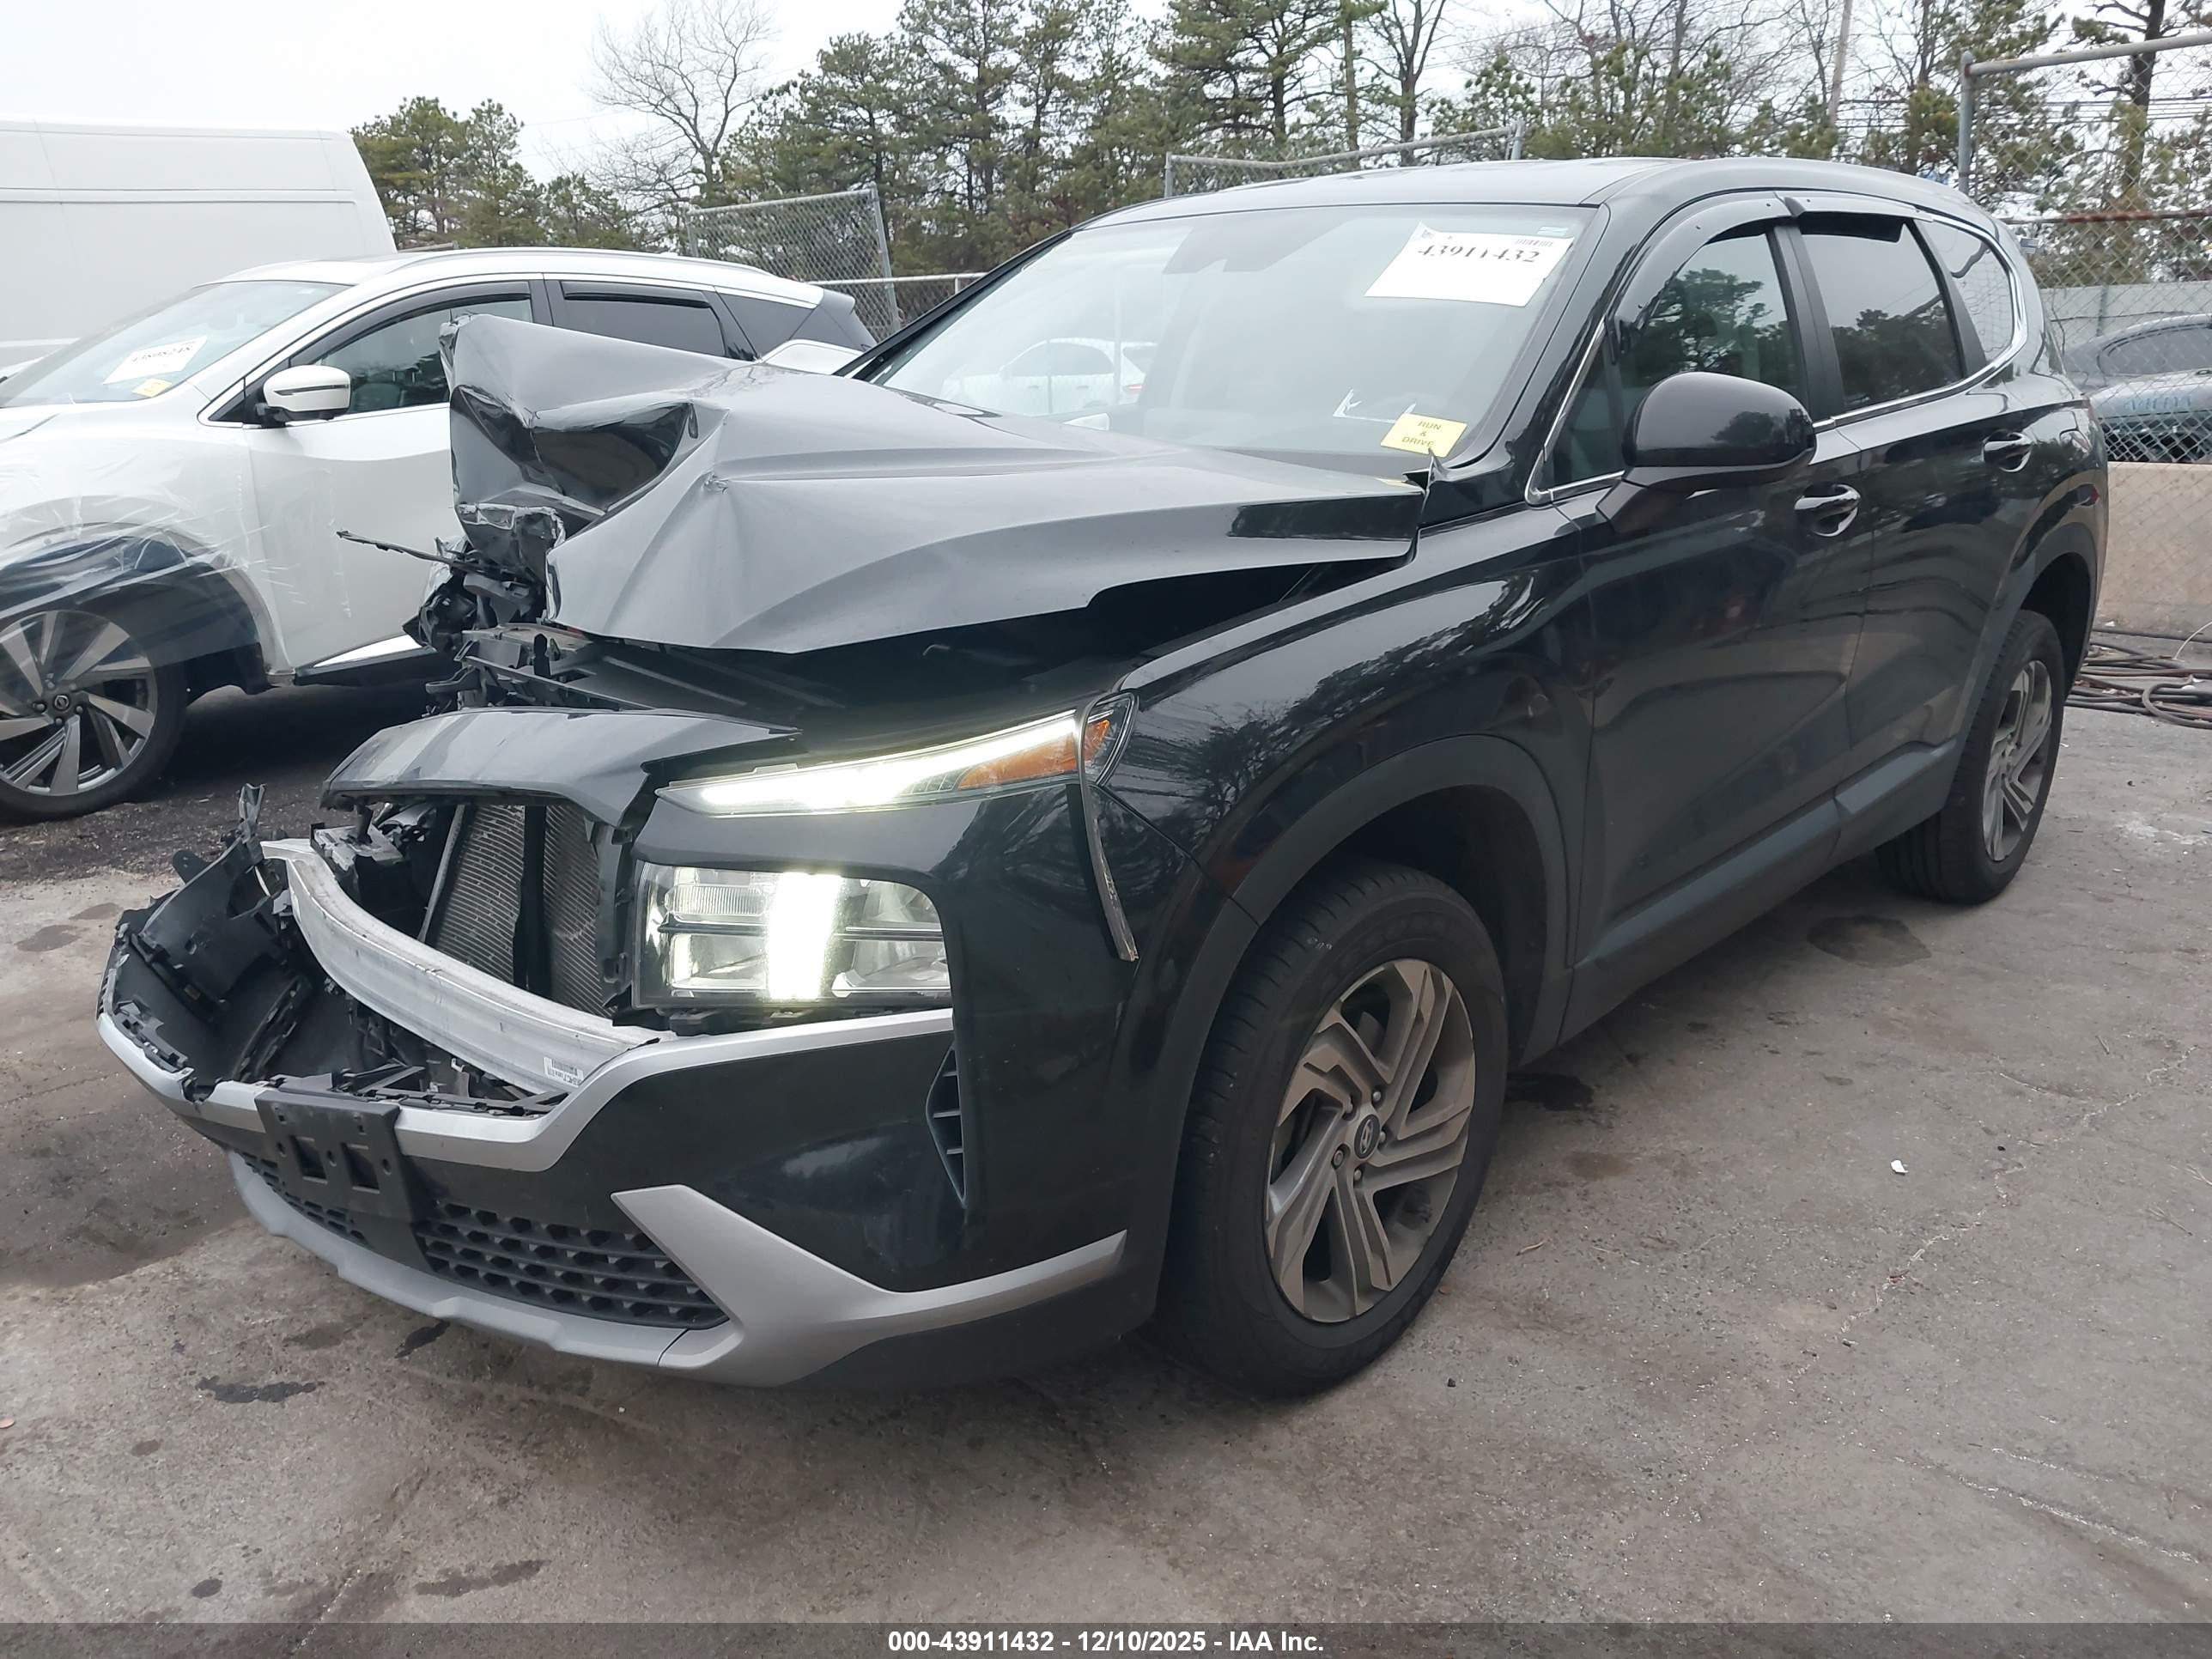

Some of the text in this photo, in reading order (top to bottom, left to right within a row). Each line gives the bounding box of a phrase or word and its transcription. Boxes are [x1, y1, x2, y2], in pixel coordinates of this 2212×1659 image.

[1418, 245, 1540, 263] 43911432
[1418, 421, 1442, 429] RUN
[1401, 436, 1434, 447] DRIVE
